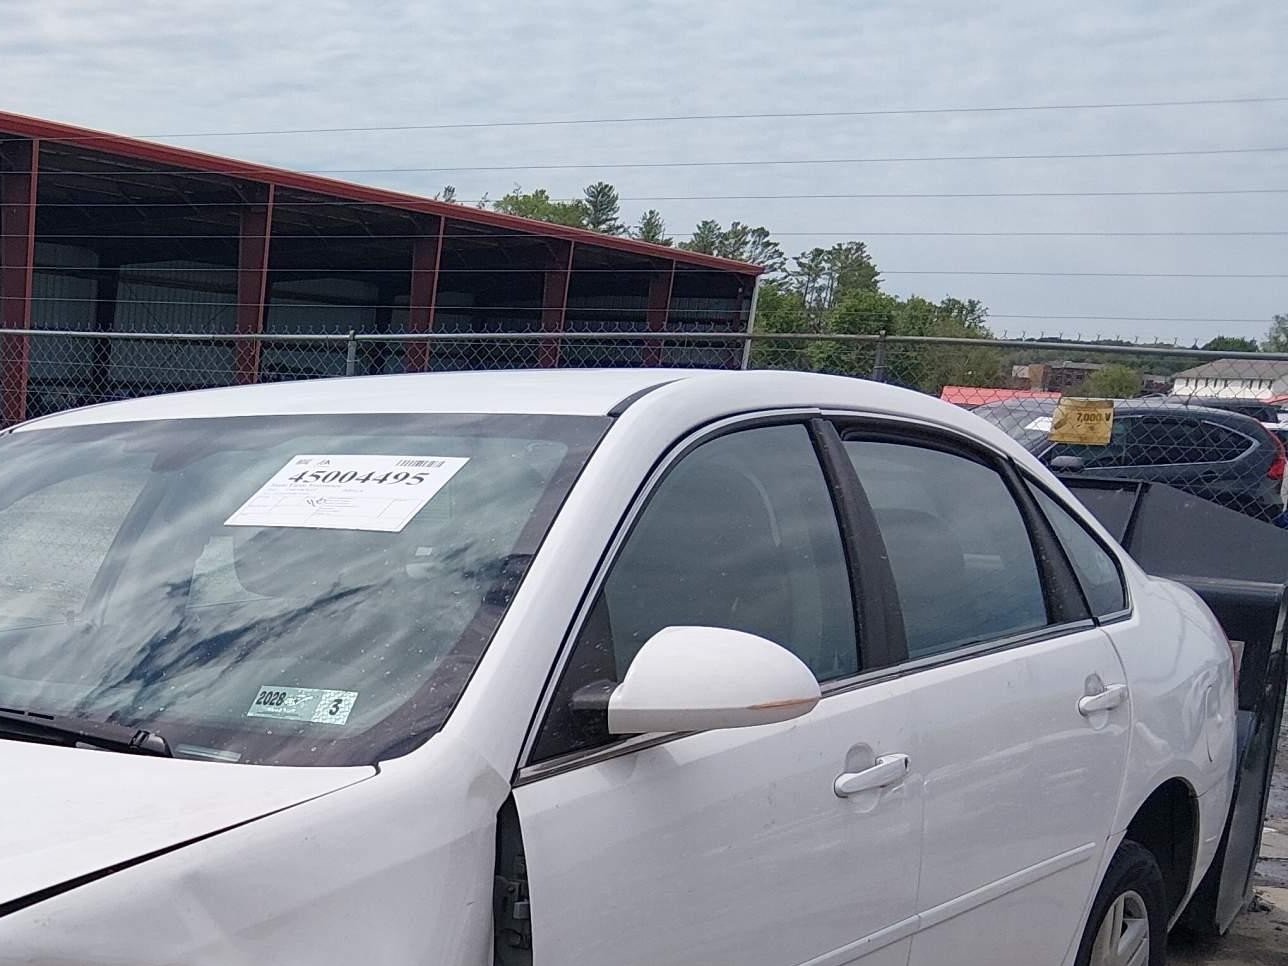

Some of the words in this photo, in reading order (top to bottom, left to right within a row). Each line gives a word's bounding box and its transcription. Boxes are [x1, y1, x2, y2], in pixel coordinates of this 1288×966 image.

[1076, 412, 1102, 423] 7,000
[1104, 412, 1112, 422] V
[288, 470, 430, 486] 45004495
[255, 691, 286, 706] 2028
[329, 699, 343, 715] 3
